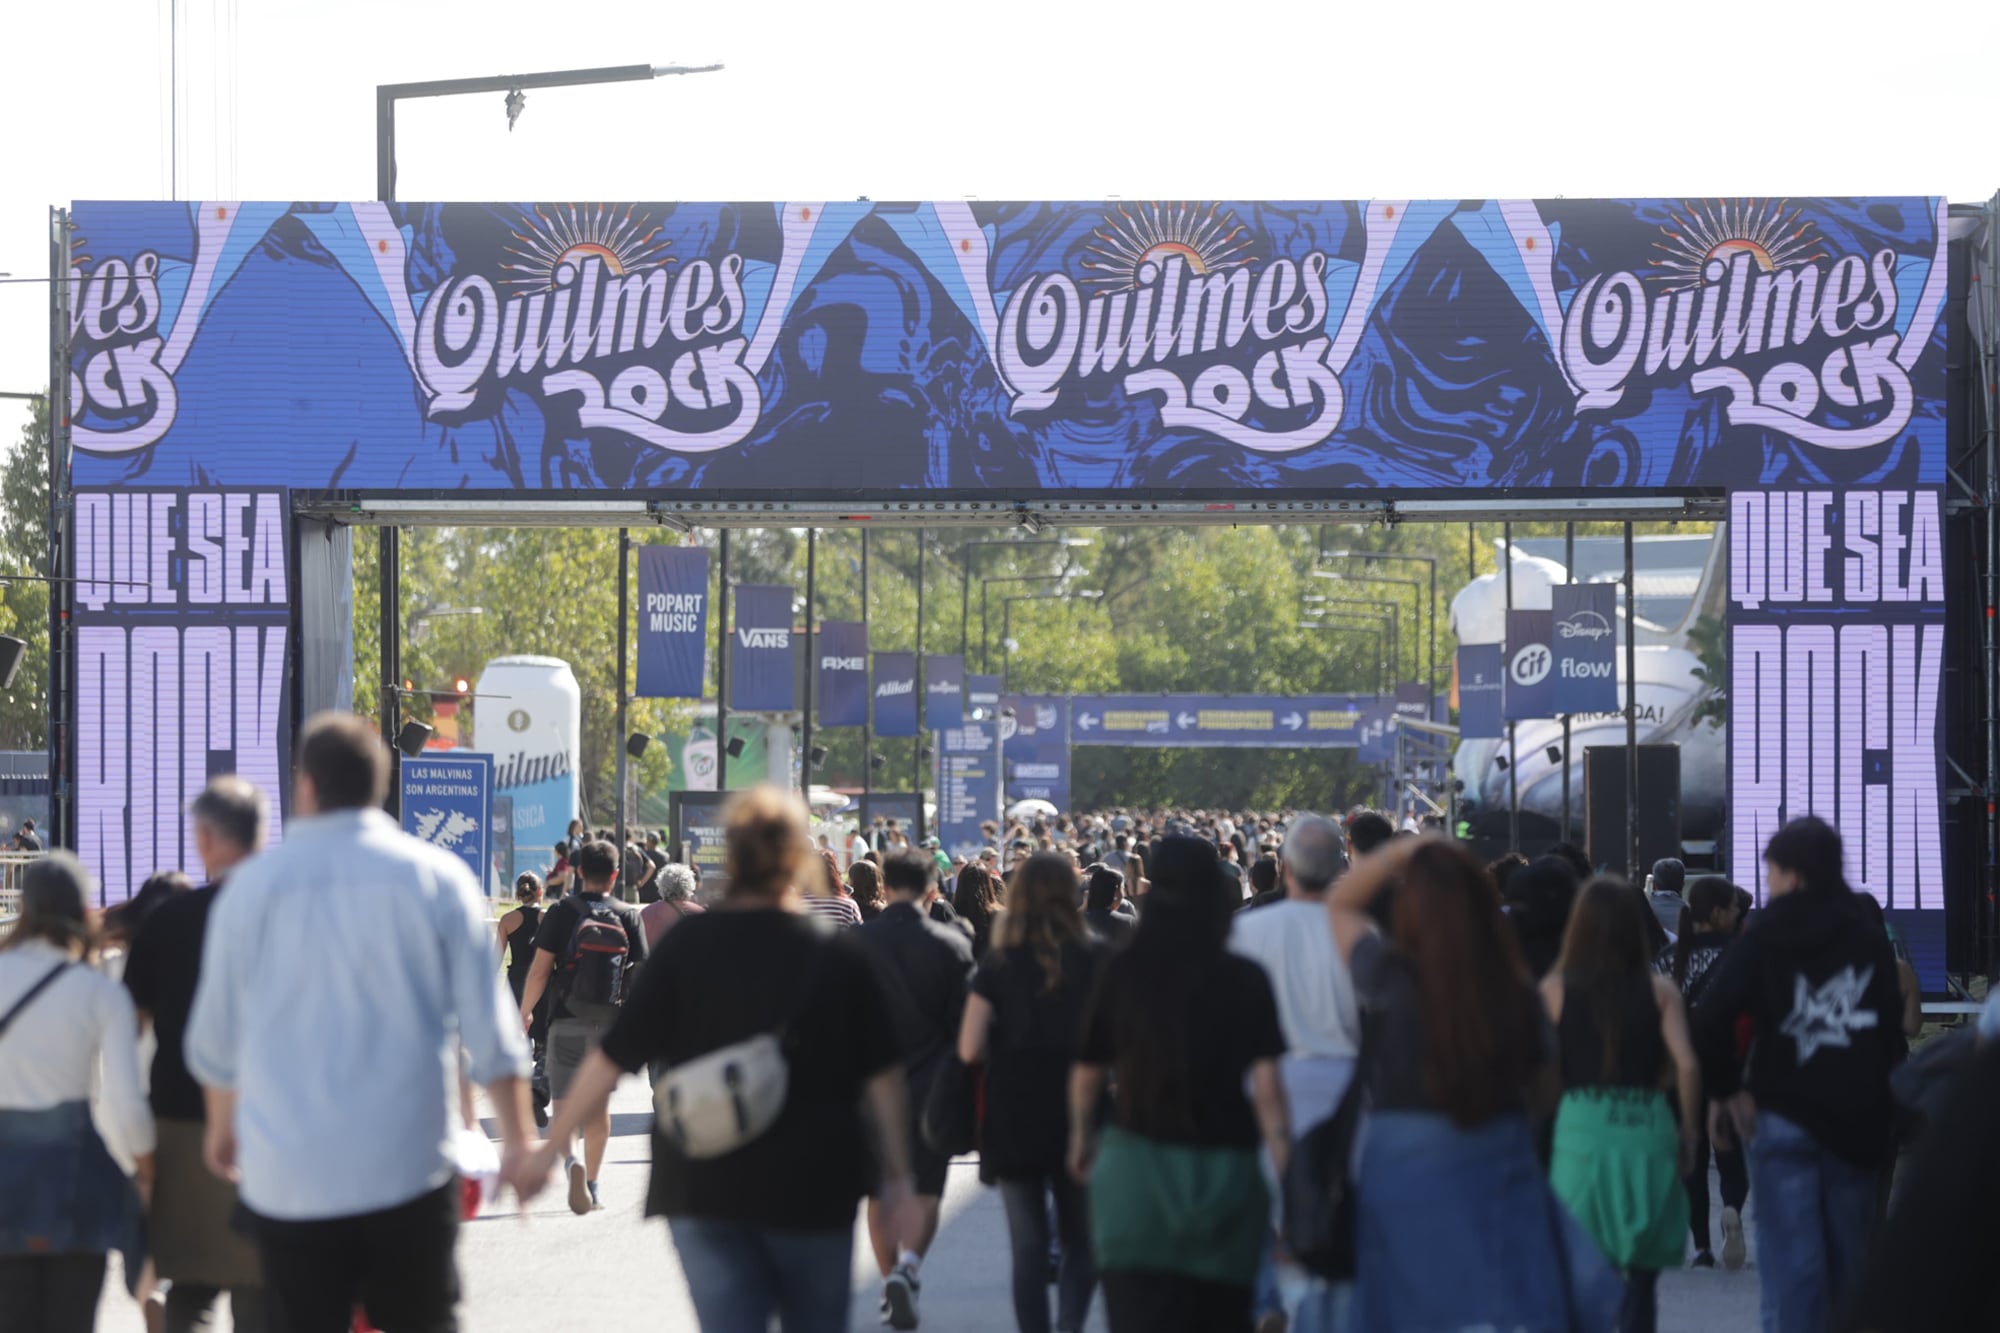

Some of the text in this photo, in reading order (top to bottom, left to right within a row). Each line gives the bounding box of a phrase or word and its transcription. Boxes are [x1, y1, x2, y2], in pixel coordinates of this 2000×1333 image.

[414, 253, 746, 419] Quilmes
[997, 252, 1327, 417] Quilmes
[1562, 249, 1897, 415] Quilmes
[76, 493, 287, 611] QUE SEA
[1731, 490, 1945, 610] QUE SEA
[647, 593, 703, 613] POPART
[650, 613, 697, 633] MUSIC
[738, 627, 790, 649] VANS
[821, 656, 864, 671] AXE
[1516, 649, 1547, 678] Cif
[1561, 657, 1612, 678] flow
[77, 626, 288, 908] ROCK
[411, 767, 473, 780] LAS MALVINAS
[1732, 624, 1945, 910] ROCK
[405, 783, 479, 797] SON ARGENTINAS
